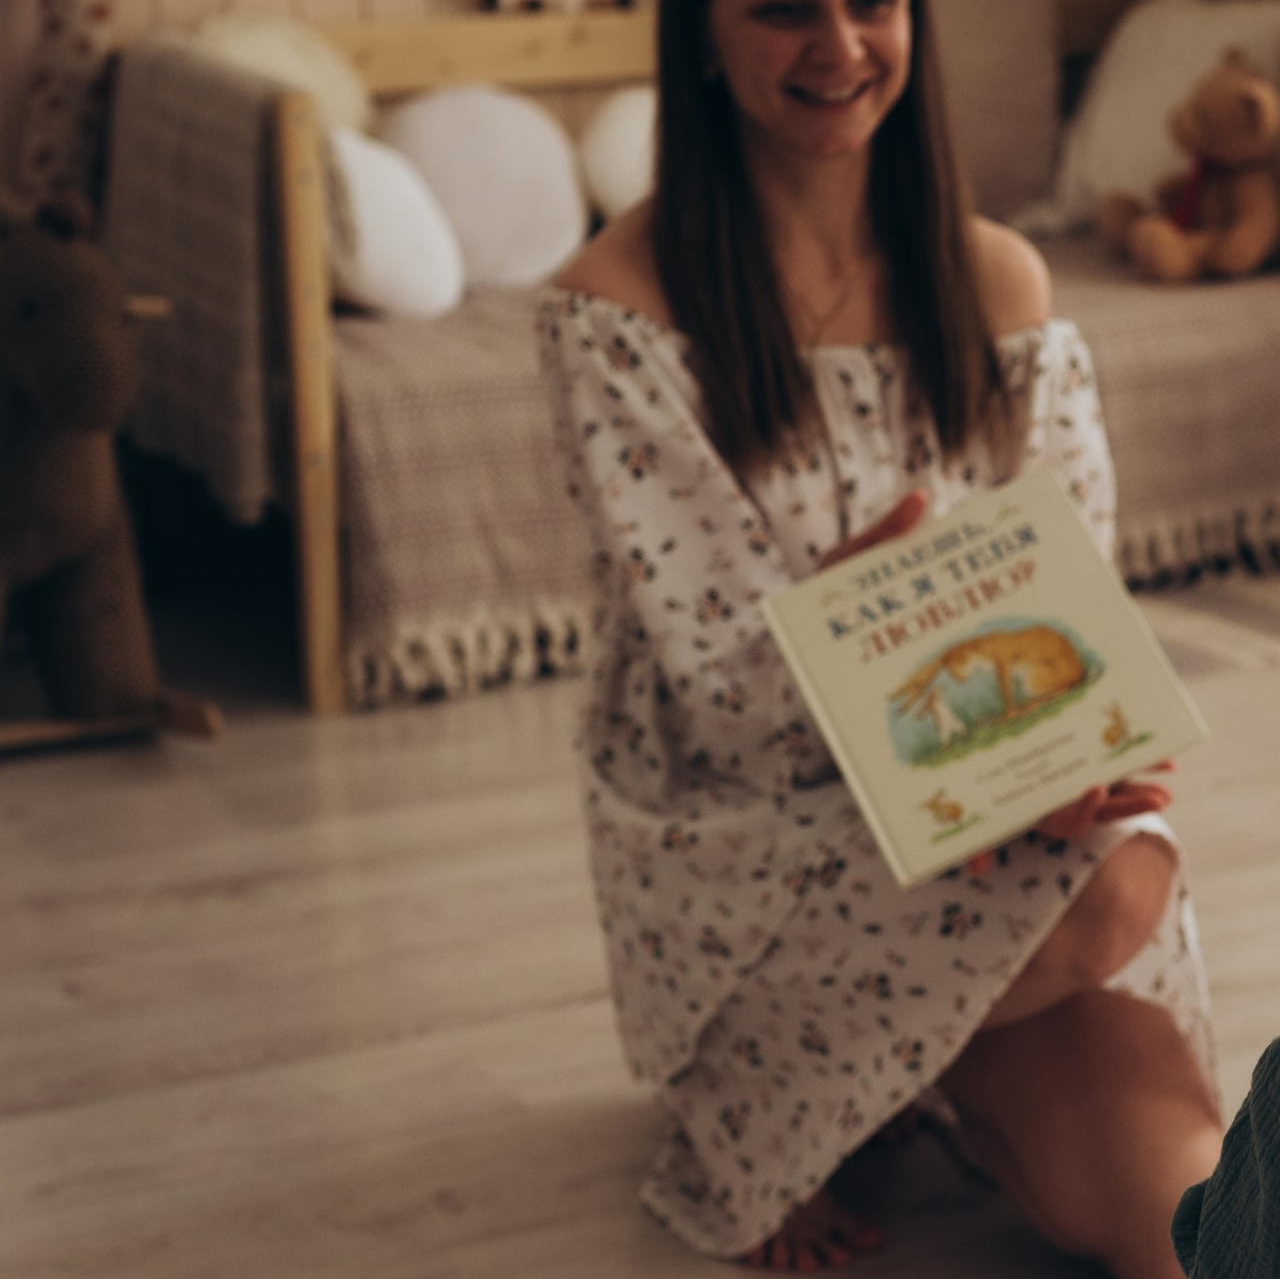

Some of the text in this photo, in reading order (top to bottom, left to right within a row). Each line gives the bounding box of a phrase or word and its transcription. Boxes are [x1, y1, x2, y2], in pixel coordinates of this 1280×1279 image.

[827, 523, 1039, 639] КАК Я ТЕБЯ
